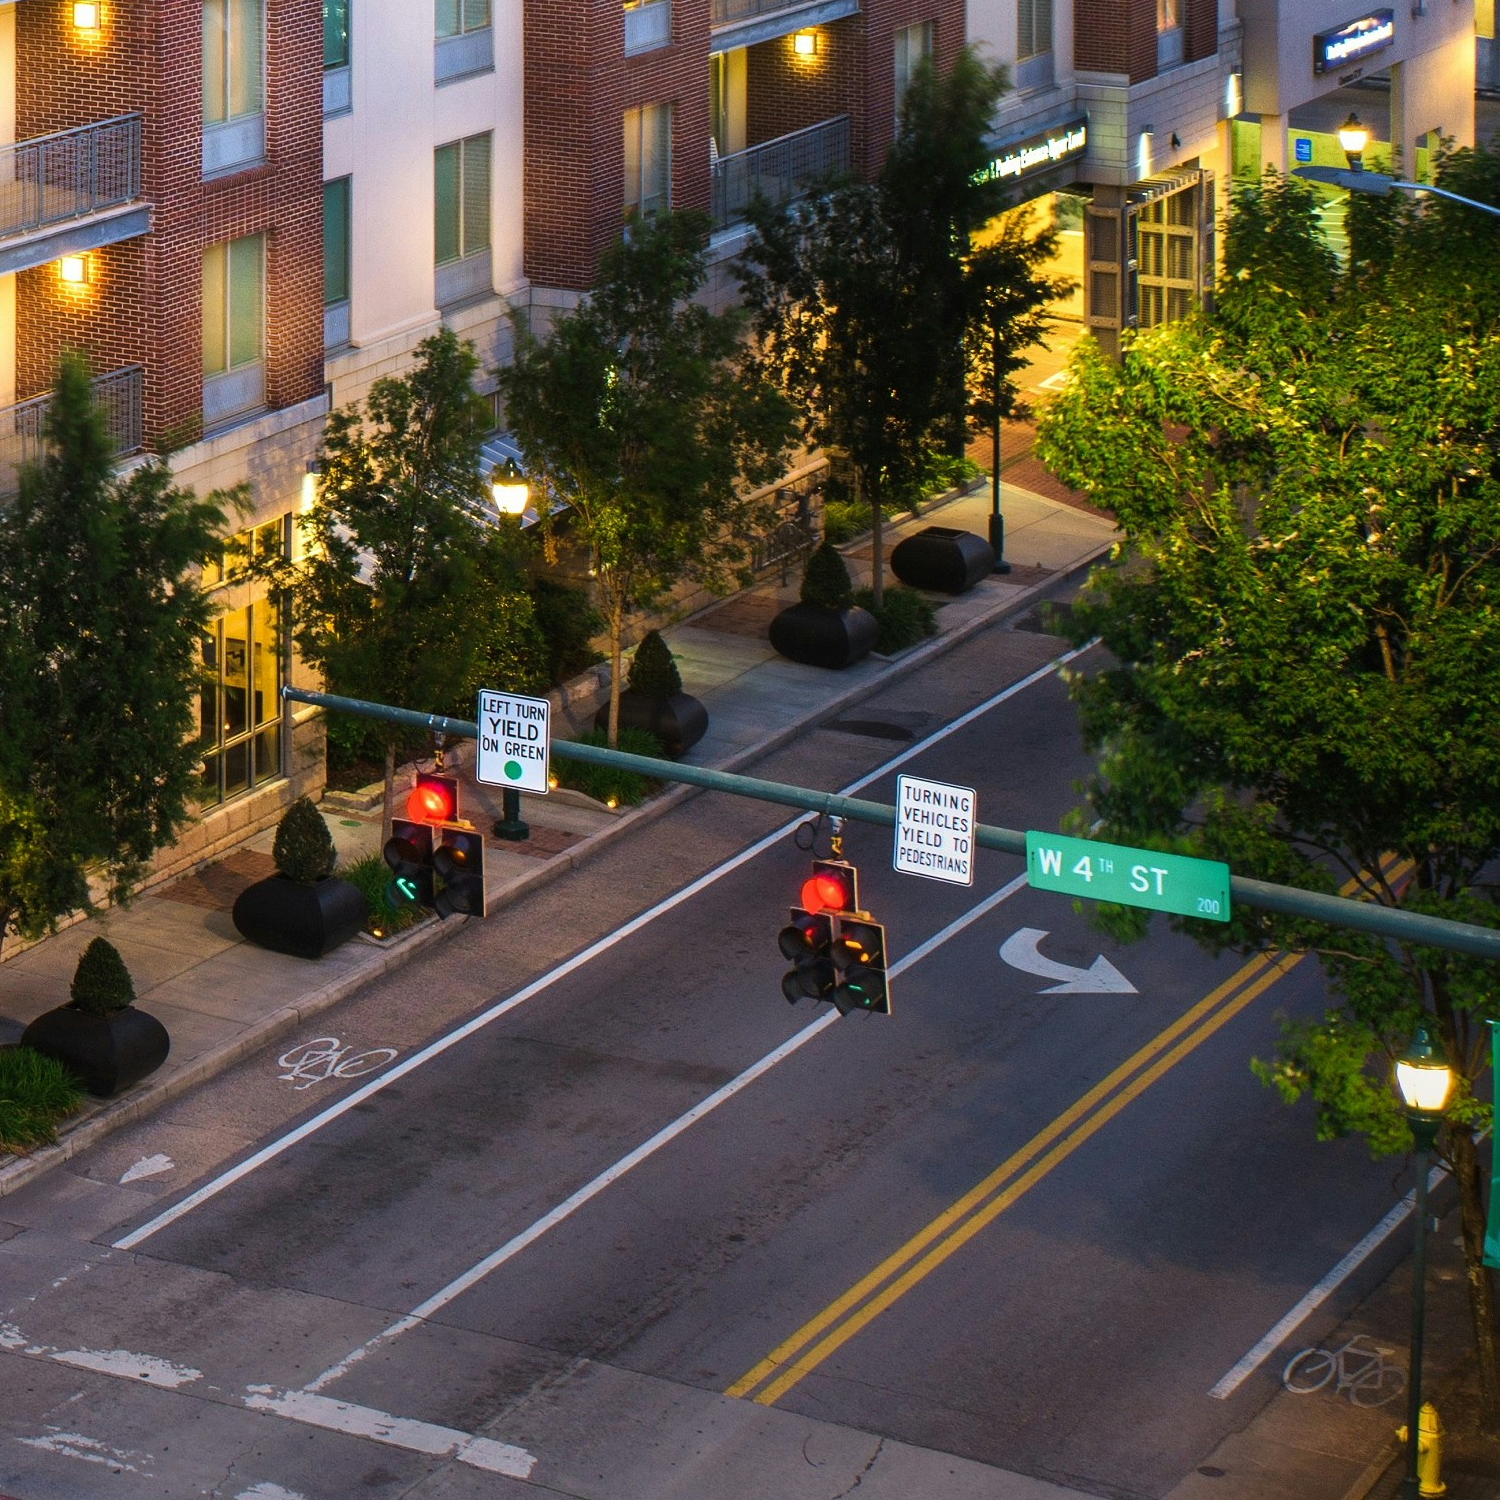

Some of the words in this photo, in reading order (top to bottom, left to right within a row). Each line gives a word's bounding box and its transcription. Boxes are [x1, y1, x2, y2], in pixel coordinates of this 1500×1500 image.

[483, 697, 511, 716] LEFT
[515, 703, 546, 722] TURN
[489, 717, 539, 741] YIELD
[482, 737, 499, 753] ON
[504, 741, 545, 761] GREEN
[904, 785, 970, 813] TURNING
[903, 806, 969, 833] VEHICLES
[902, 827, 943, 848] YIELD
[952, 837, 969, 854] TO
[899, 846, 968, 875] PEDESTRIANS
[1037, 847, 1063, 877] W
[1129, 865, 1169, 896] ST
[1197, 897, 1221, 916] 200
